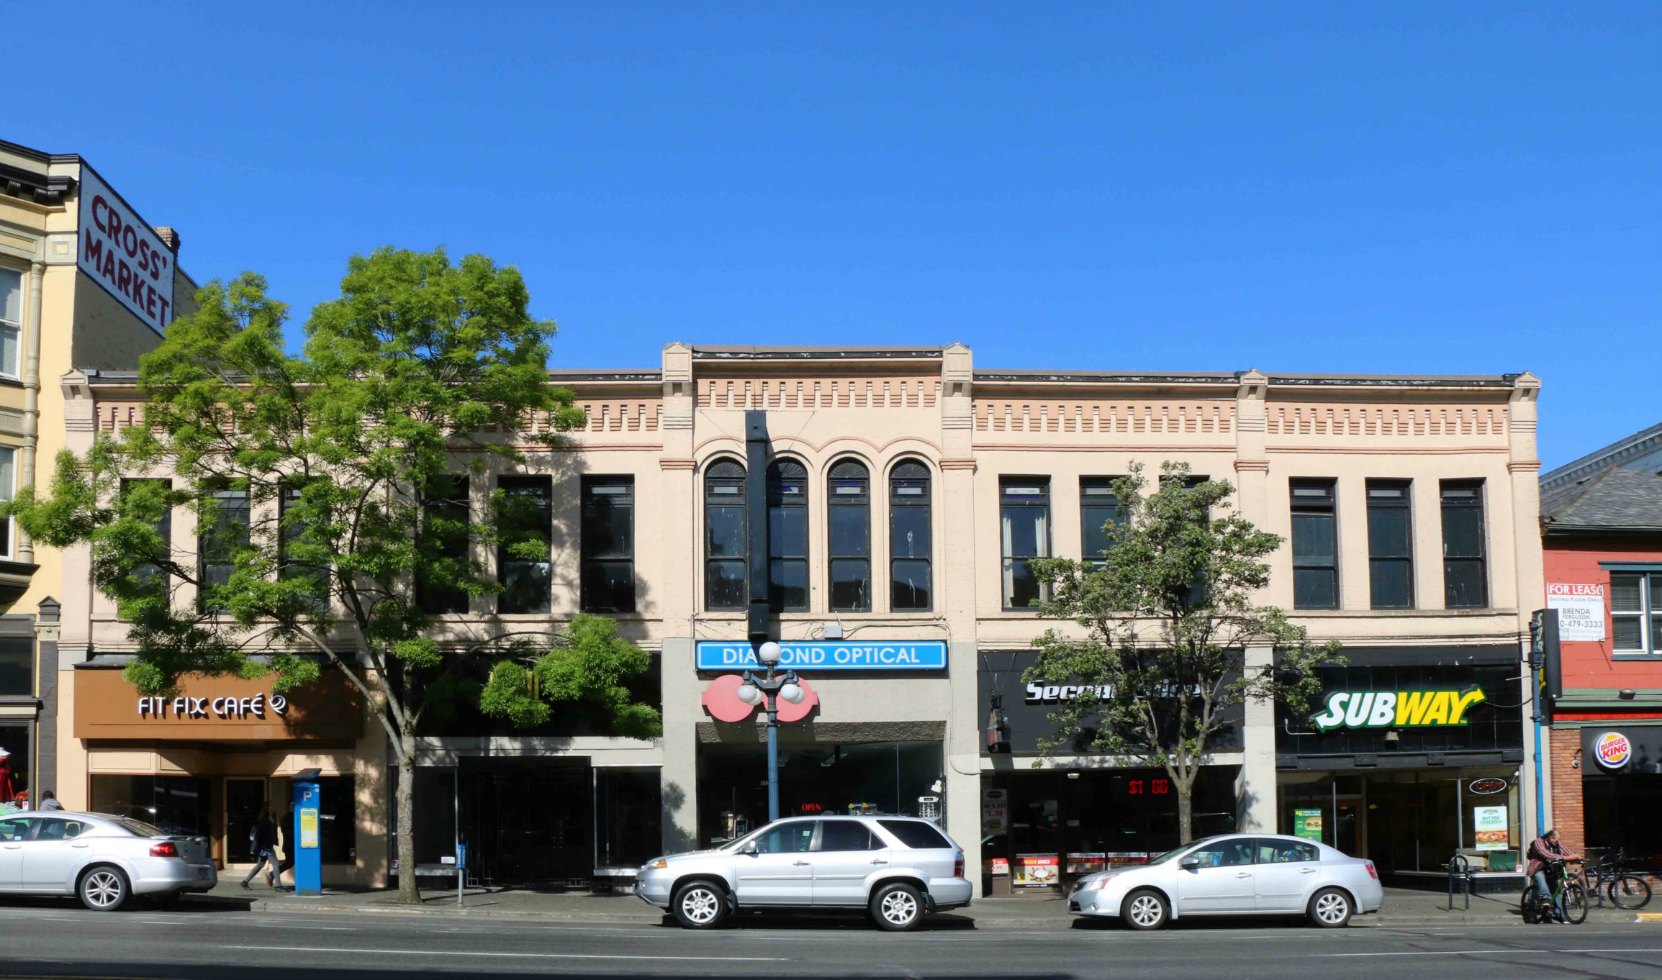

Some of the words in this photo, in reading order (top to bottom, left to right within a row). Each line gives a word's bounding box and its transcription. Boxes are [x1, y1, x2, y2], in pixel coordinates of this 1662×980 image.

[85, 228, 170, 327] MARKET
[1549, 585, 1569, 594] FOR
[1572, 585, 1602, 595] LEASE
[723, 648, 825, 664] DIAOND
[834, 648, 920, 664] OPTICAL
[1025, 679, 1116, 701] Secon
[138, 697, 166, 715] FIT
[173, 697, 206, 715] FIX
[212, 692, 263, 715] CAFÉ
[1316, 688, 1486, 728] SUBWAY
[1600, 737, 1626, 751] BURGER
[1602, 743, 1627, 760] KING
[303, 791, 313, 802] P
[801, 803, 822, 811] OPEN
